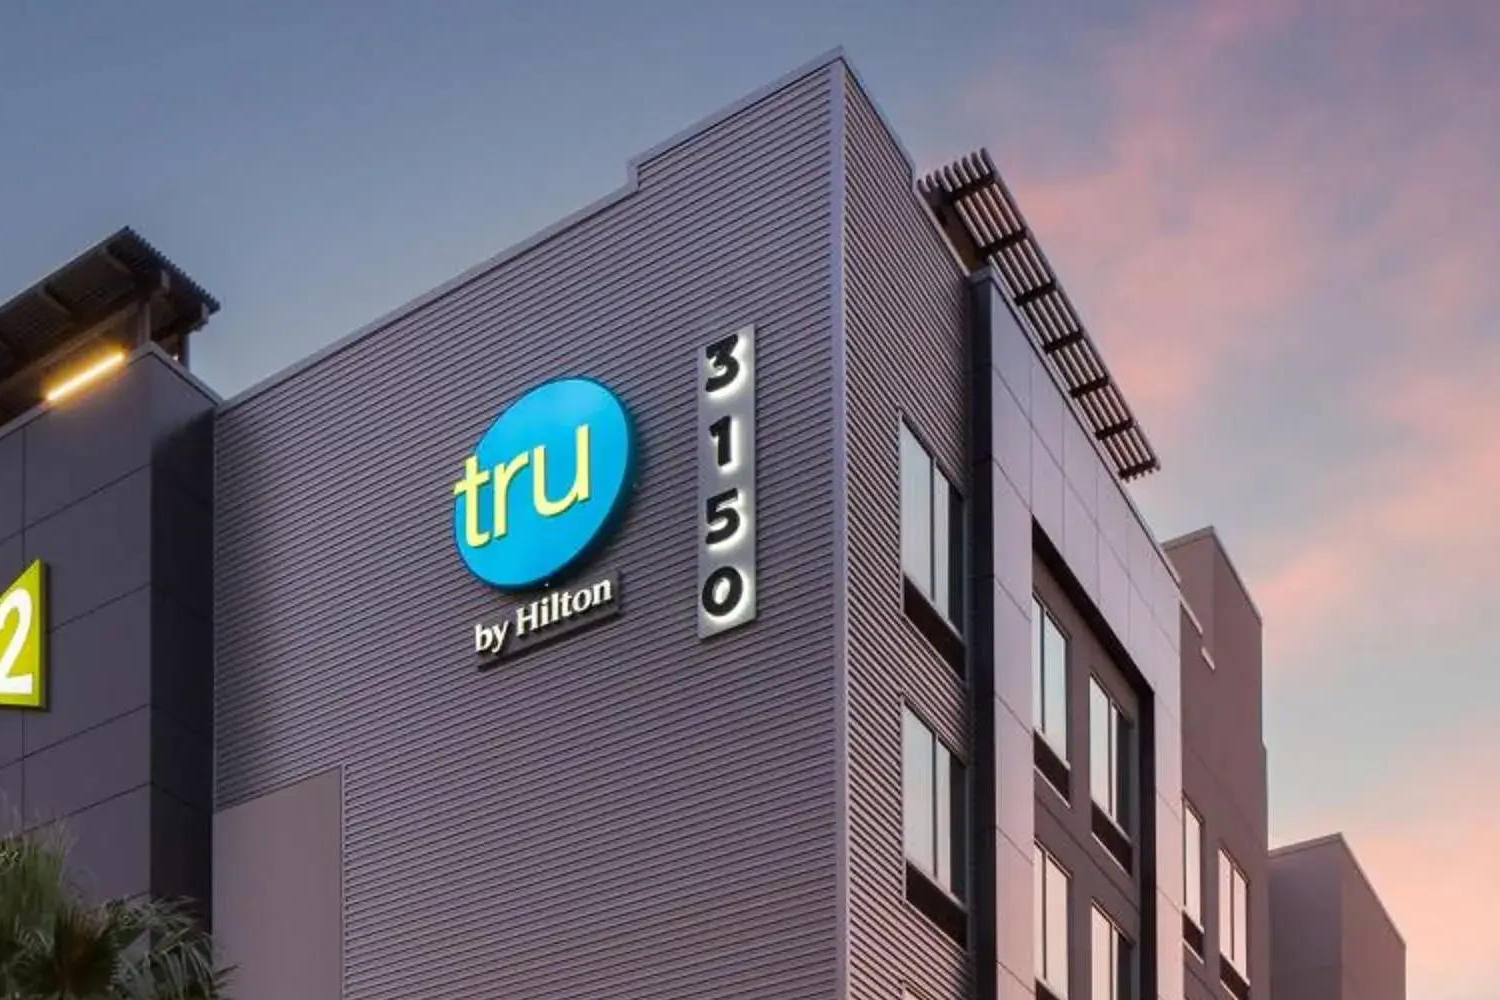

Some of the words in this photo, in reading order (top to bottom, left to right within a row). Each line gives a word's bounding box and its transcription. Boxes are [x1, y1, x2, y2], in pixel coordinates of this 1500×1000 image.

[453, 424, 590, 548] tru
[701, 332, 744, 618] 3150
[475, 619, 509, 653] by
[516, 579, 612, 636] Hilton
